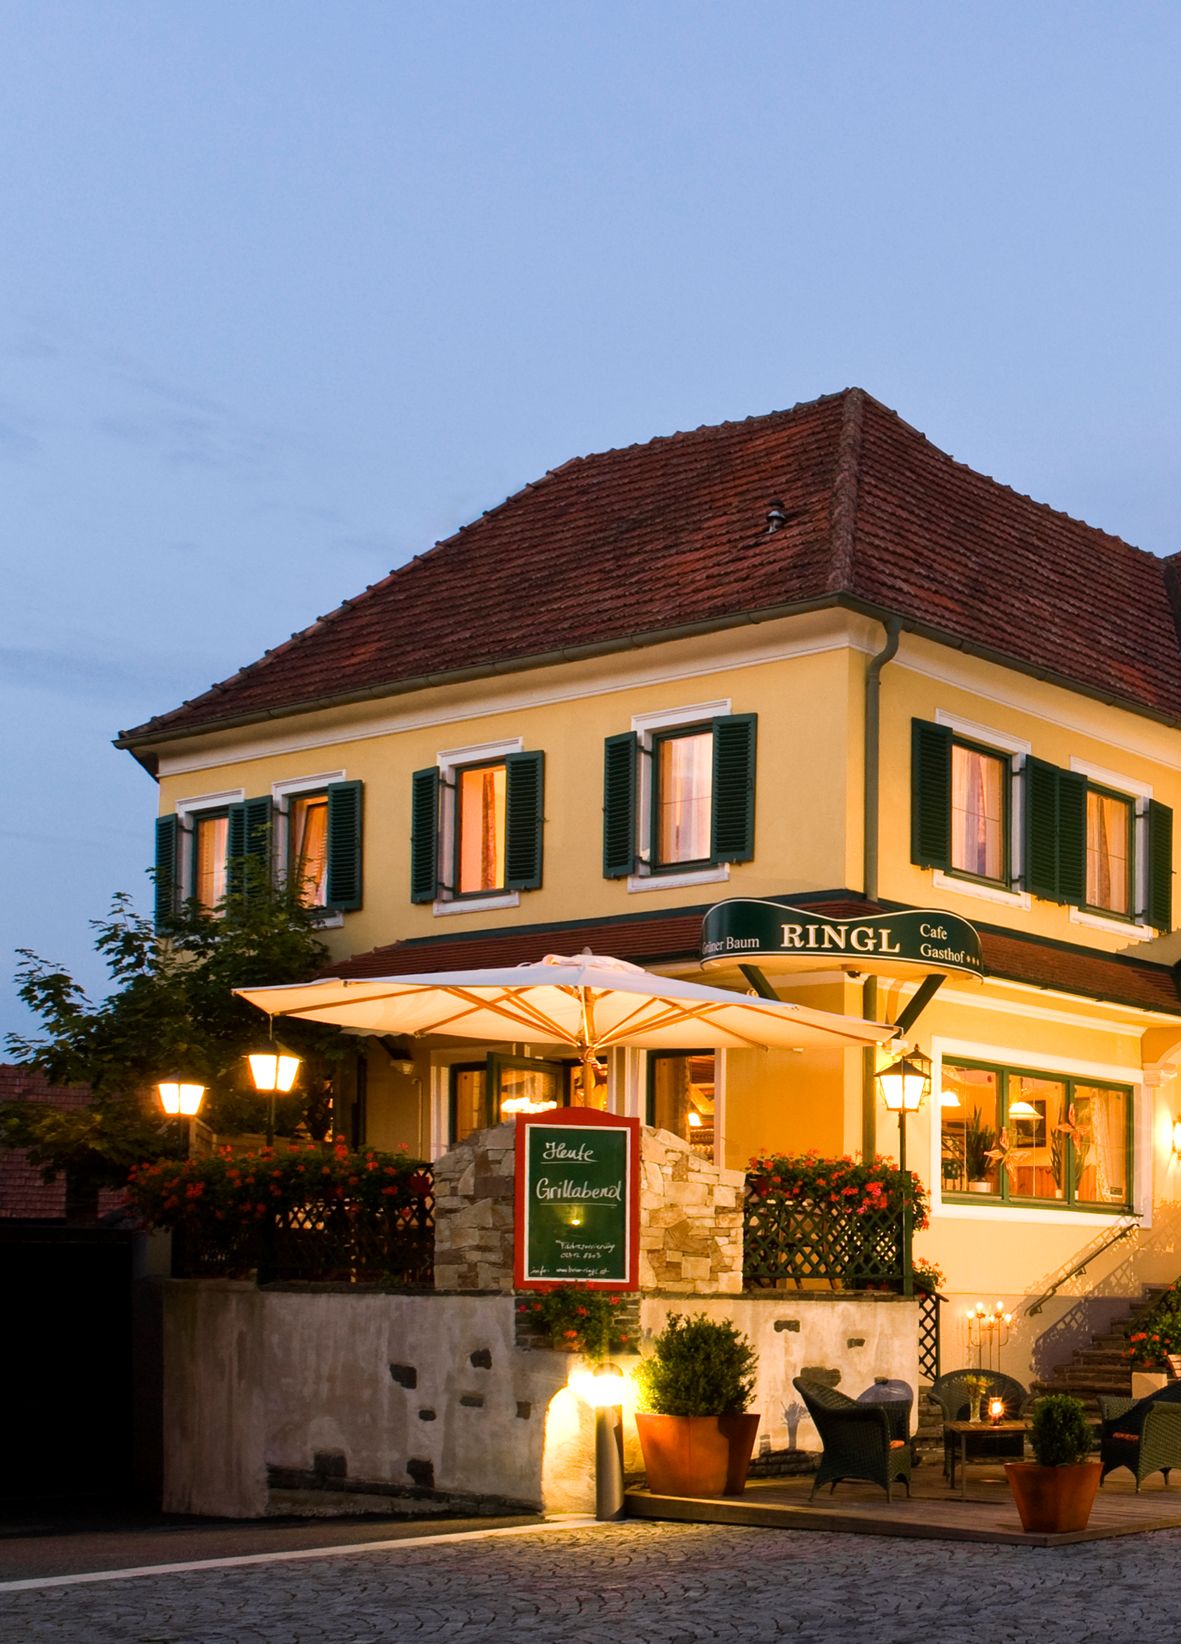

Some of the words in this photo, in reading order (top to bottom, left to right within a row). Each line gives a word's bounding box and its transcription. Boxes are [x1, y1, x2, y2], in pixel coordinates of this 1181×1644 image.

[780, 924, 900, 953] RINGL
[920, 923, 948, 940] Cafe
[726, 936, 760, 950] Baum
[920, 943, 965, 963] Gasthof
[542, 1141, 599, 1162] Heute
[536, 1177, 622, 1202] Grillabend
